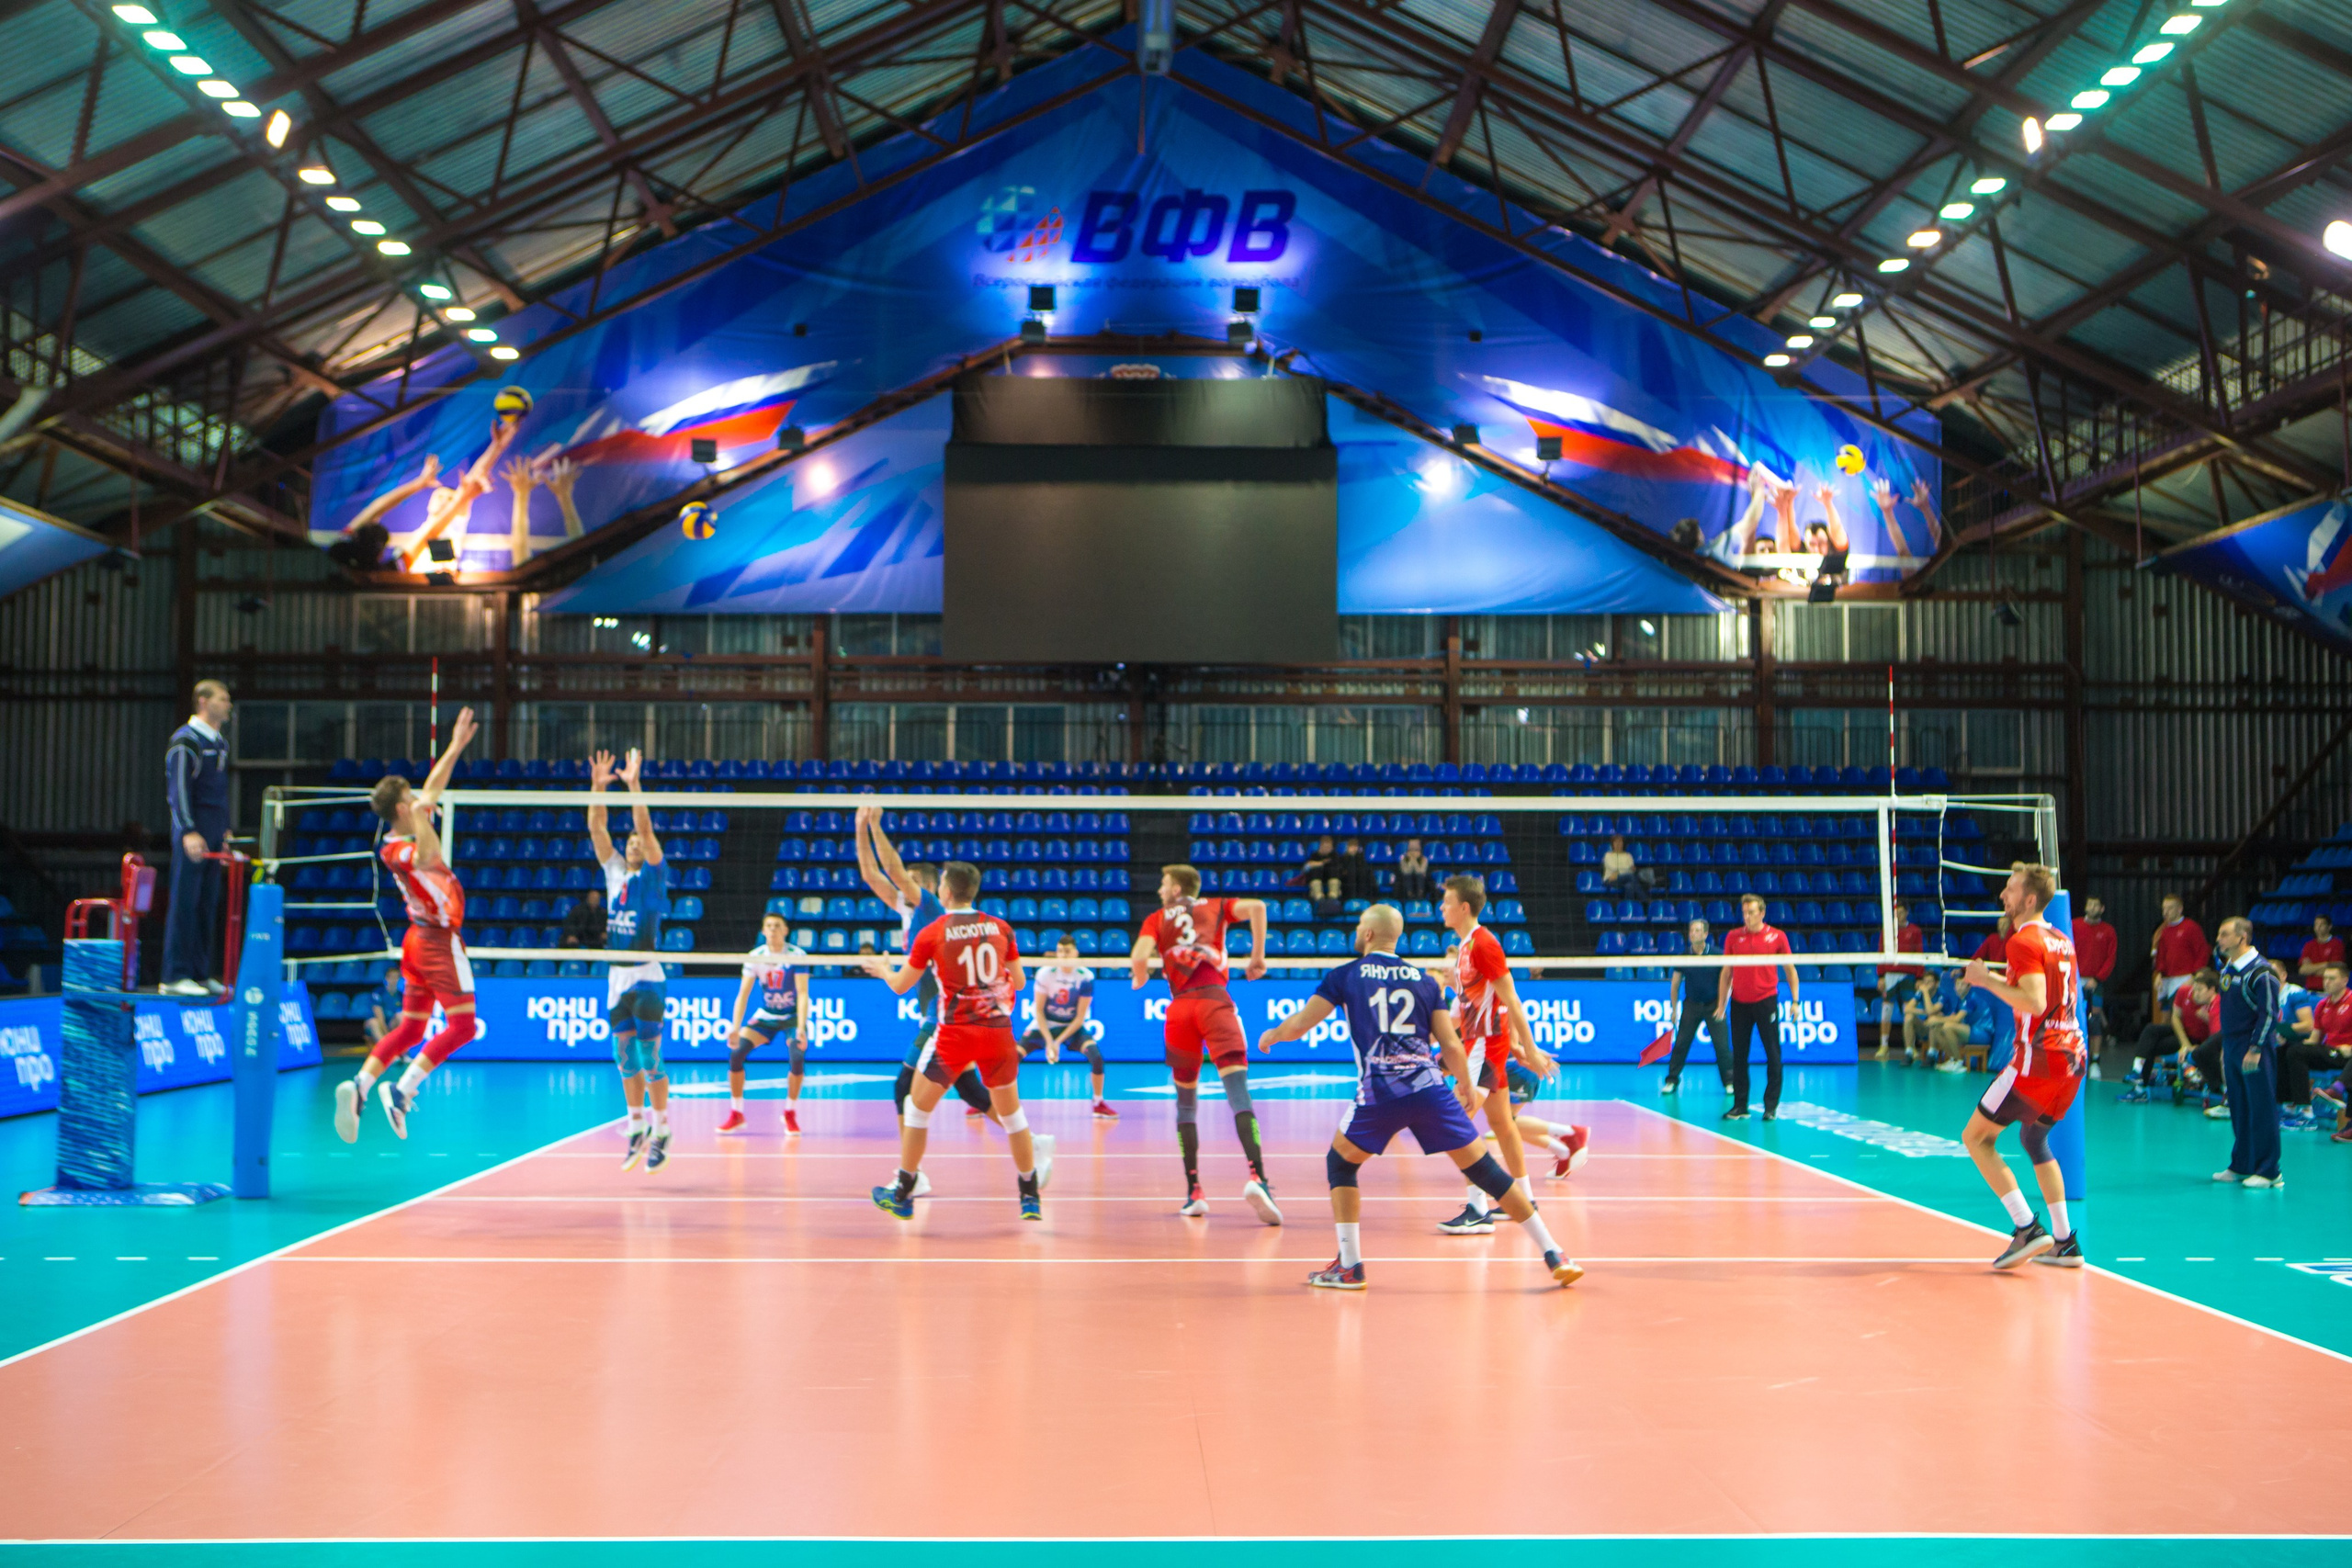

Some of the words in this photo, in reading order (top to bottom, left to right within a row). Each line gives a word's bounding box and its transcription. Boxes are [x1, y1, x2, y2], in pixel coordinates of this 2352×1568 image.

[1071, 188, 1297, 263] ВФВ
[945, 922, 1000, 942] АКСЮТИН
[1174, 914, 1196, 945] 3
[767, 970, 784, 989] 17
[957, 942, 998, 987] 10
[1361, 964, 1421, 981] ЯНУТОВ
[2058, 961, 2071, 1006] 7
[1369, 987, 1416, 1034] 12
